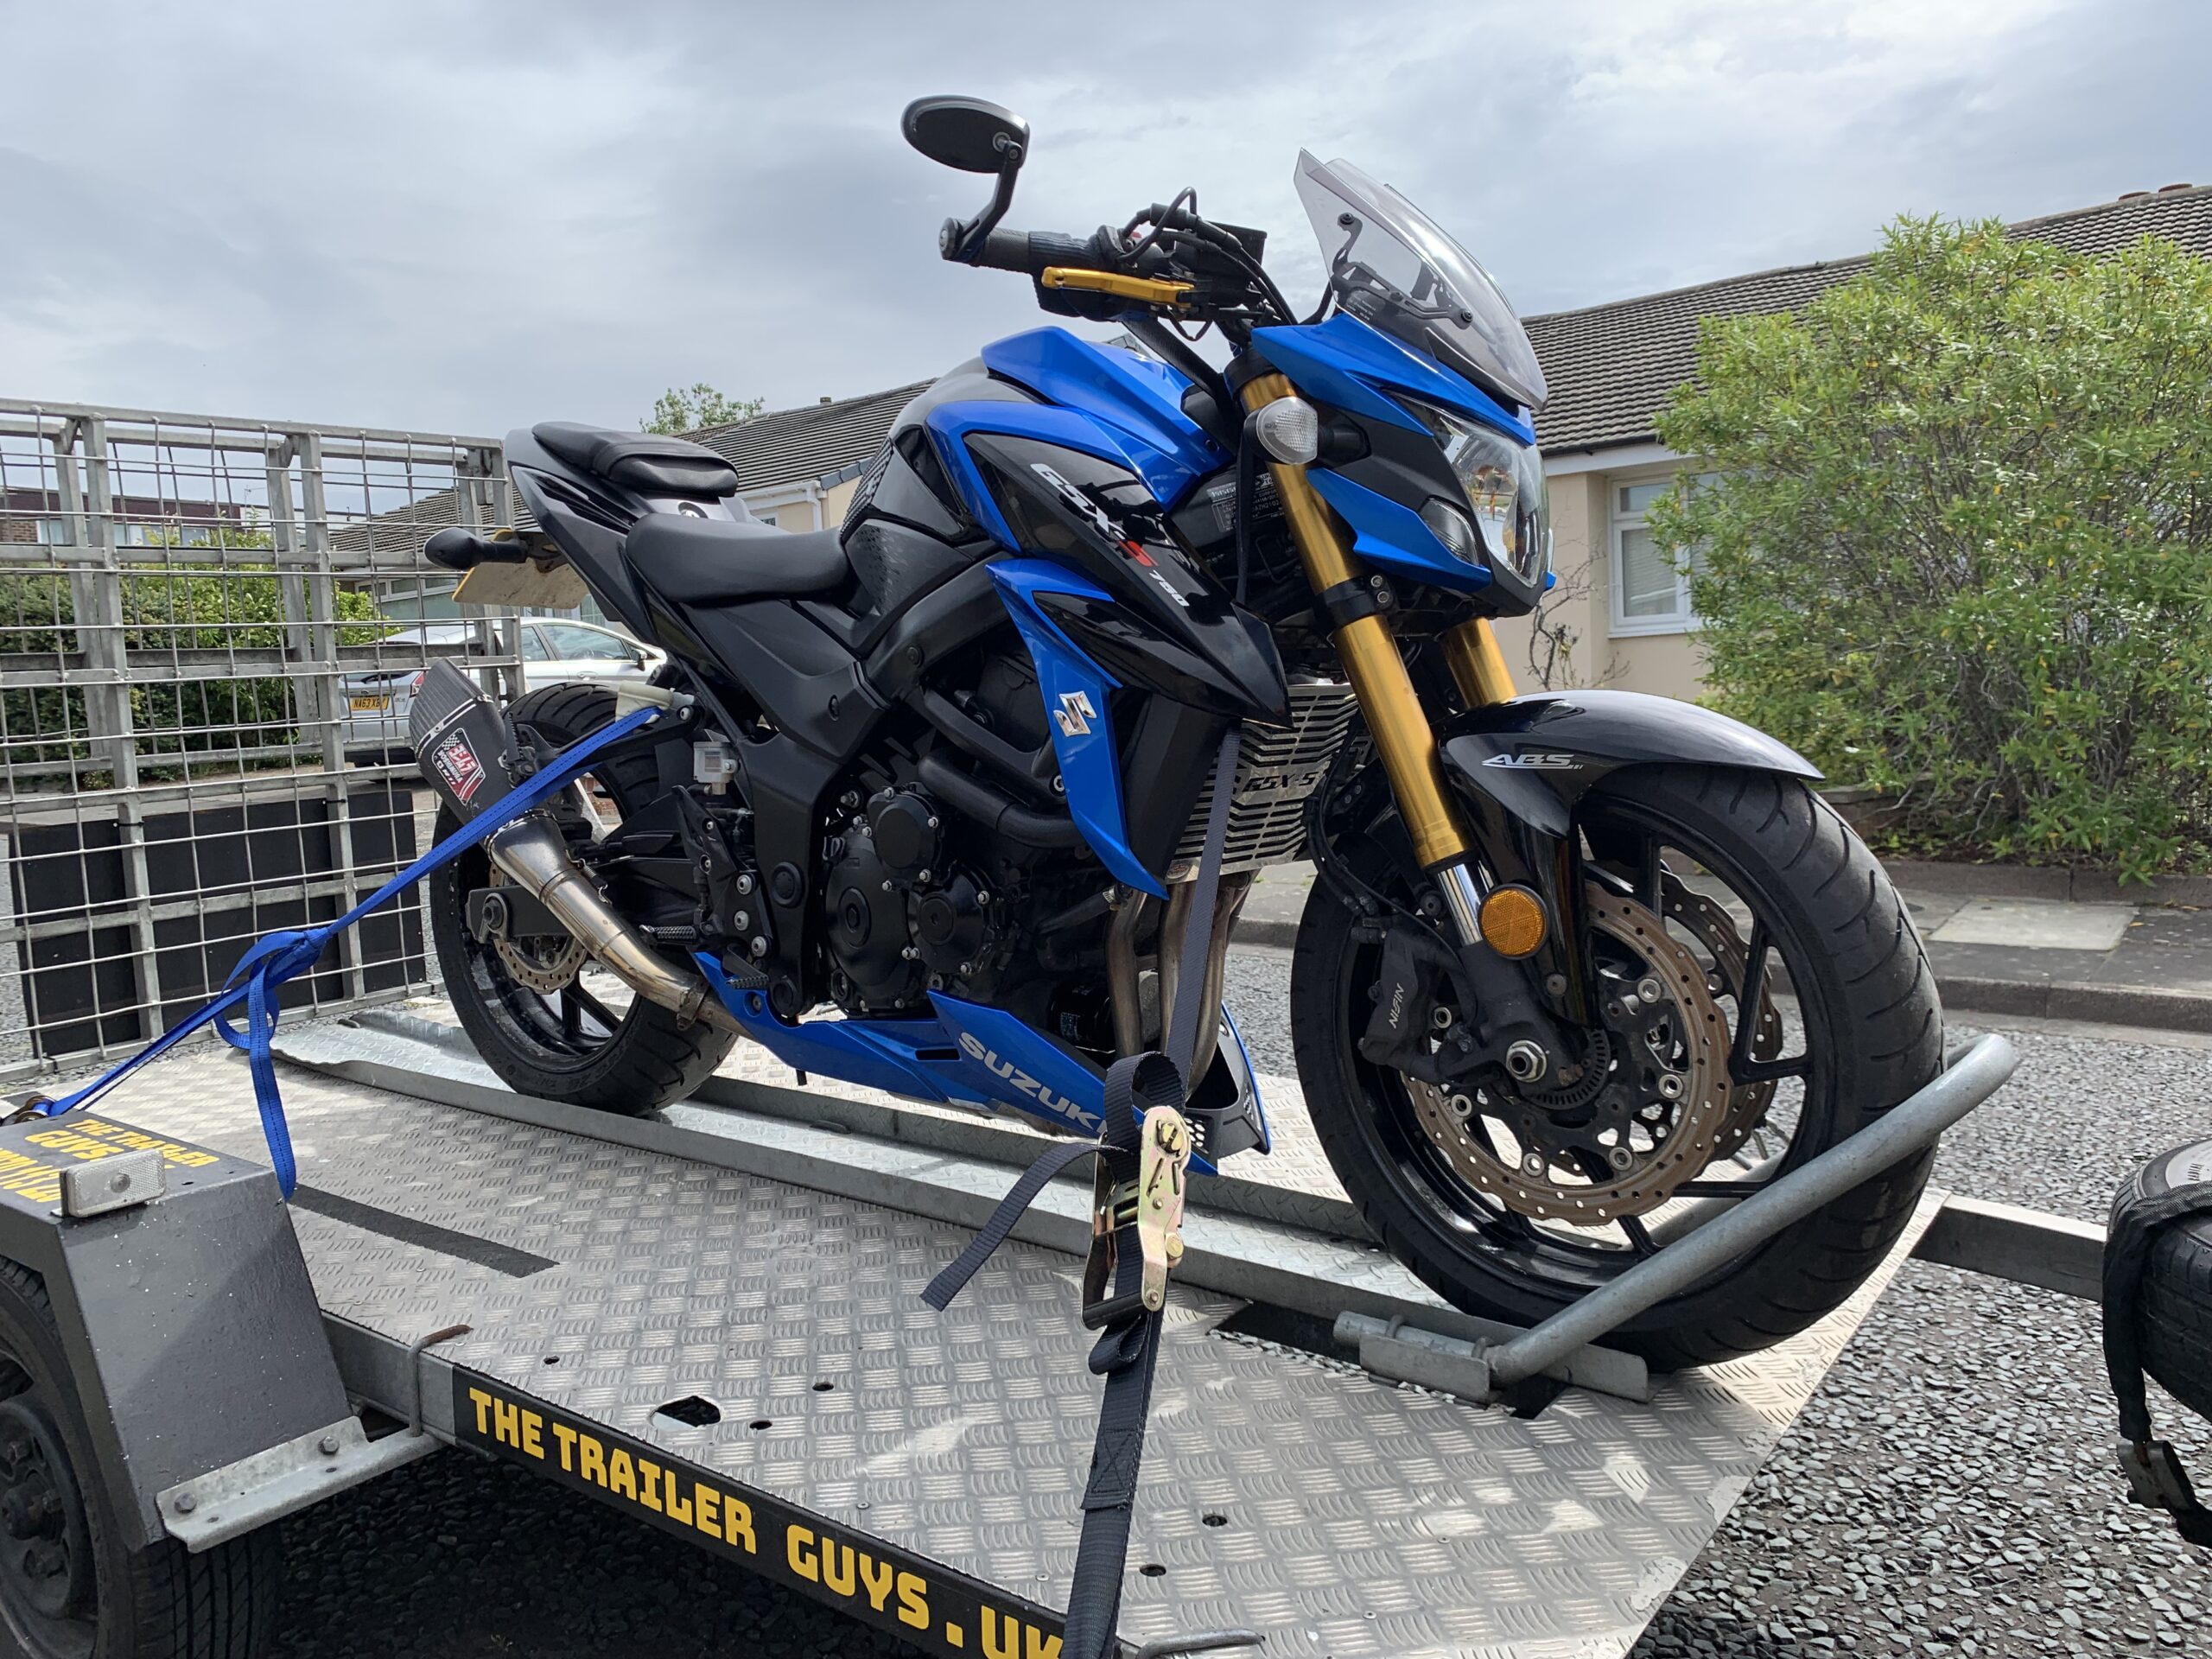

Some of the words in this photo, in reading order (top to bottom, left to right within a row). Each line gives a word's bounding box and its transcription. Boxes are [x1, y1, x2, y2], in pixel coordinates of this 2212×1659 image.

[1149, 569, 1190, 607] 750
[437, 750, 464, 784] YOSHIMURA
[1481, 753, 1576, 767] ABS
[1389, 982, 1405, 1029] NISSIN
[24, 1130, 125, 1160] GUYS
[66, 1119, 125, 1136] THE
[105, 1131, 220, 1168] TRAILER
[469, 1387, 545, 1458] THE
[551, 1421, 757, 1555] TRAILER
